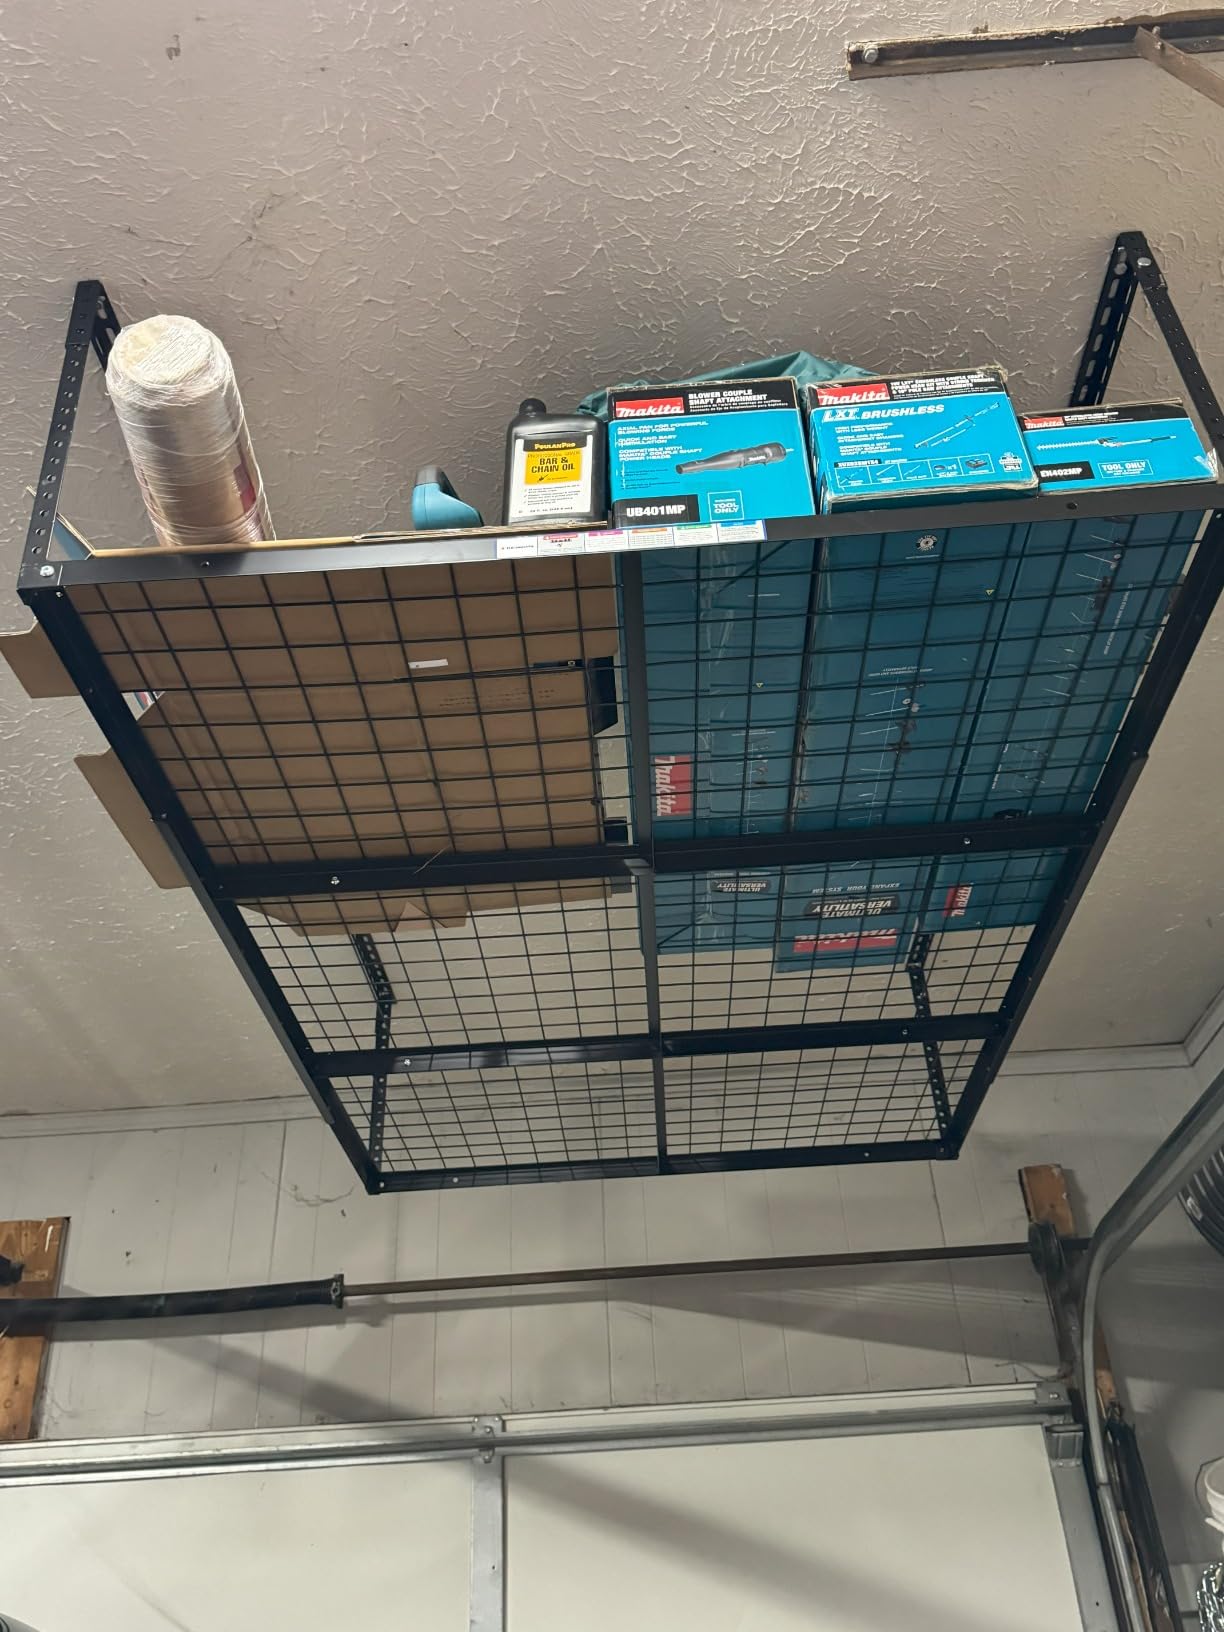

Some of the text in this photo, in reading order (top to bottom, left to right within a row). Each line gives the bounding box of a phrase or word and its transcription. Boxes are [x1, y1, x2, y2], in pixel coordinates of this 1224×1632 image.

[688, 389, 753, 400] BLOWER COUPLE
[688, 398, 714, 406] SHAFT
[716, 394, 768, 403] ATTACHMENT
[822, 404, 945, 423] LXT BRUSHLESS
[540, 456, 569, 466] BAR &
[1101, 461, 1146, 471] TOOL ONLY
[531, 463, 575, 473] CHAIN OIL
[626, 504, 686, 517] UB401MP
[812, 900, 892, 913] VERSATILITY
[822, 908, 883, 918] ULTIMATE
